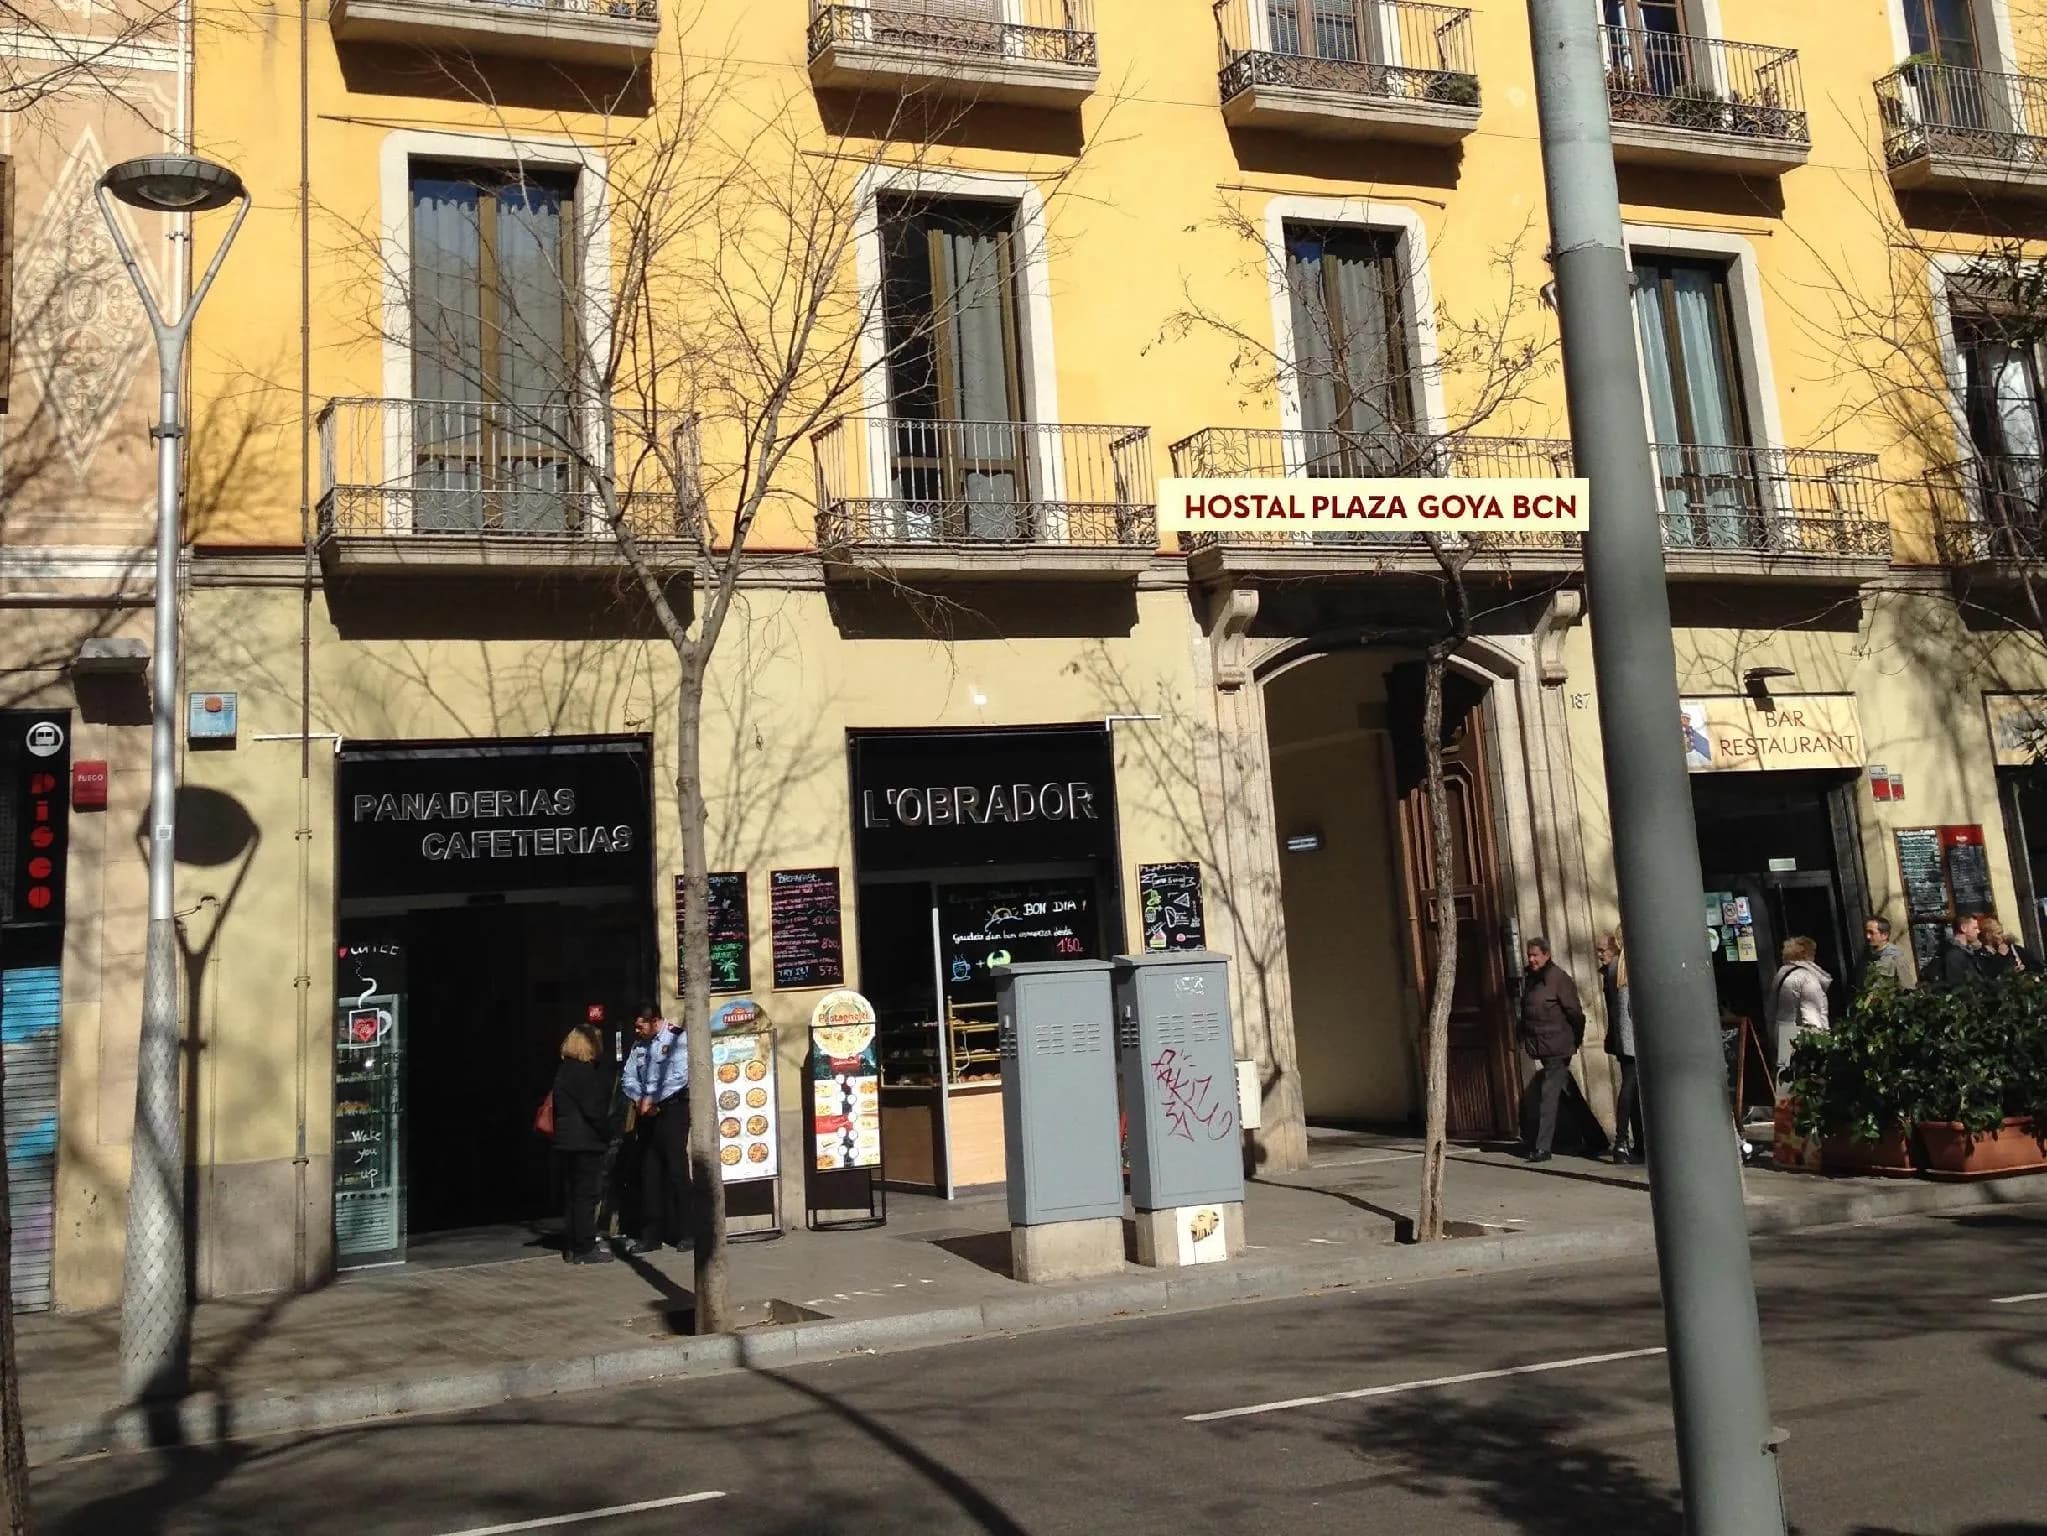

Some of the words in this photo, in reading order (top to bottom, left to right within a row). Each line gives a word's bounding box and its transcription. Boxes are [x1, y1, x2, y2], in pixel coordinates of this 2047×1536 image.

[1569, 692, 1591, 709] 187
[1765, 710, 1806, 729] BAR
[1719, 734, 1856, 757] RESTAURANT
[353, 788, 576, 823] PANADERIAS
[864, 782, 1099, 828] L'OBRADOR
[422, 825, 633, 860] CAFETERIAS
[1023, 902, 1047, 915] BON
[1052, 901, 1077, 912] DIA
[354, 1148, 377, 1164] you
[360, 1169, 378, 1188] up
